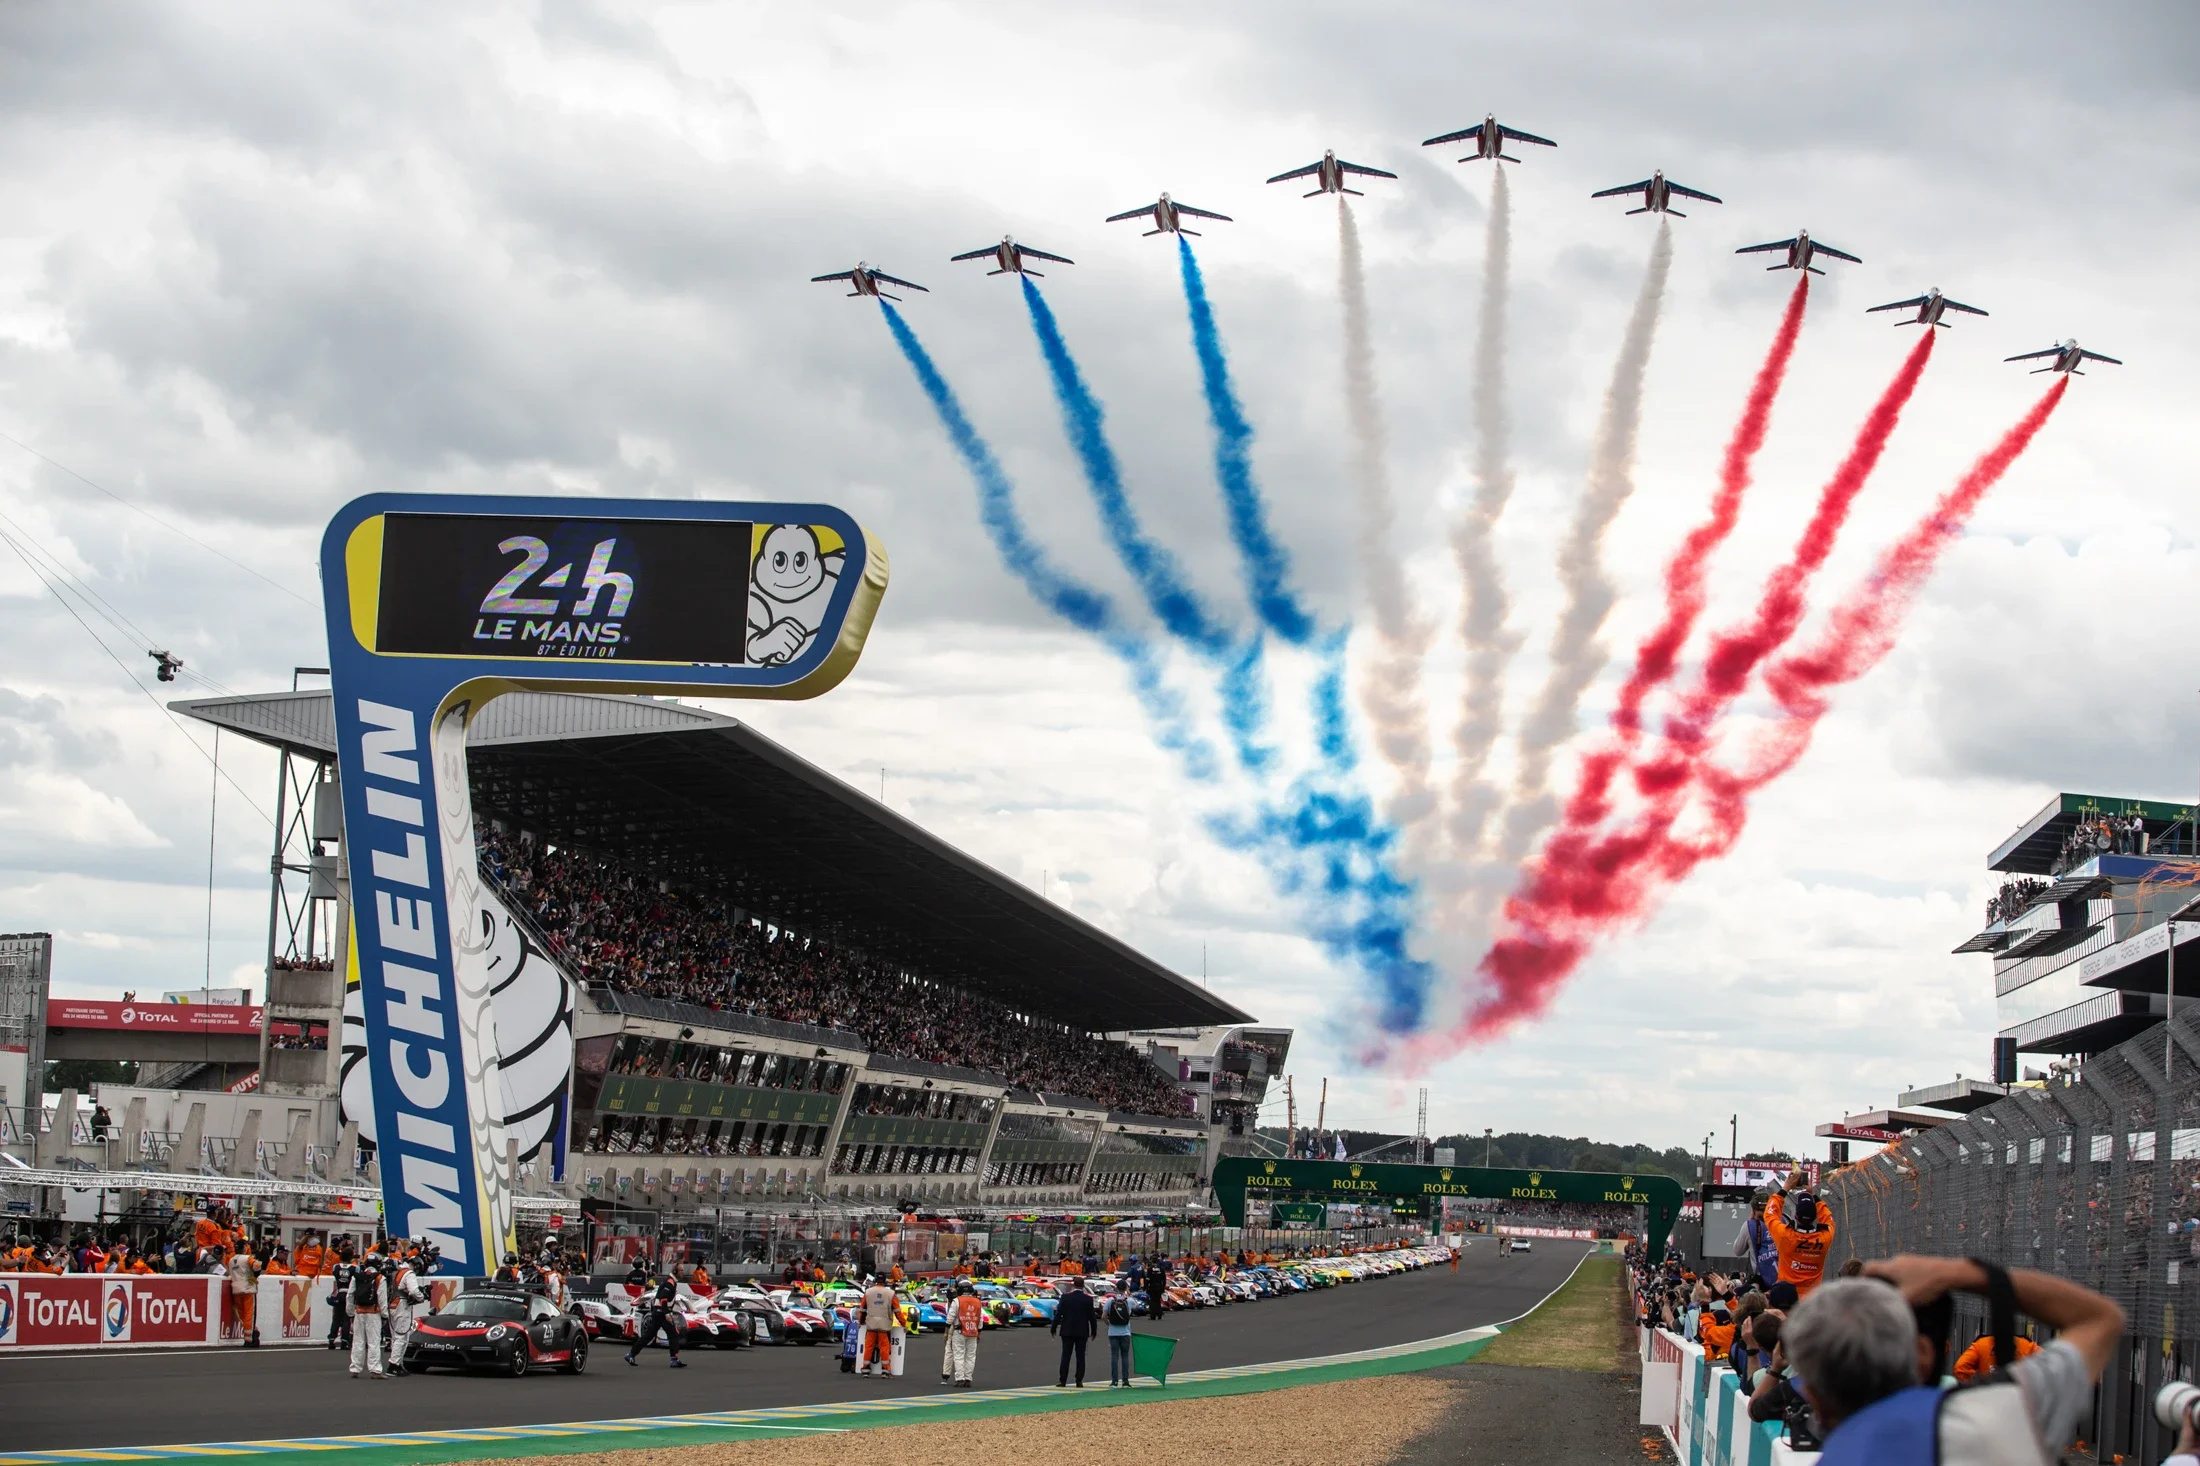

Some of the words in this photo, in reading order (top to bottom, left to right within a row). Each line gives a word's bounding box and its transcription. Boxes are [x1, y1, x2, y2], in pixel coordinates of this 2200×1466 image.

[480, 535, 634, 617] 24h
[473, 618, 517, 640] LE
[520, 620, 622, 643] MANS
[559, 643, 617, 658] ÉDITION
[357, 699, 467, 1265] MICHELIN
[137, 1011, 179, 1023] TOTAL
[1881, 1130, 1900, 1139] TOT
[1714, 1159, 1745, 1168] MOTUL
[1246, 1175, 1293, 1188] ROLEX
[1332, 1179, 1378, 1191] ROLEX
[1423, 1183, 1469, 1195] ROLEX
[1511, 1187, 1557, 1199] ROLEX
[1604, 1191, 1650, 1203] ROLEX
[1289, 1213, 1311, 1221] ROLEX
[1731, 1208, 1738, 1219] 2
[24, 1291, 97, 1327] TOTAL
[137, 1291, 203, 1325] TOTAL
[584, 1306, 599, 1315] DENSO
[220, 1321, 231, 1339] Le
[288, 1320, 310, 1338] Mans
[424, 1342, 445, 1351] Leading
[445, 1343, 456, 1351] Car
